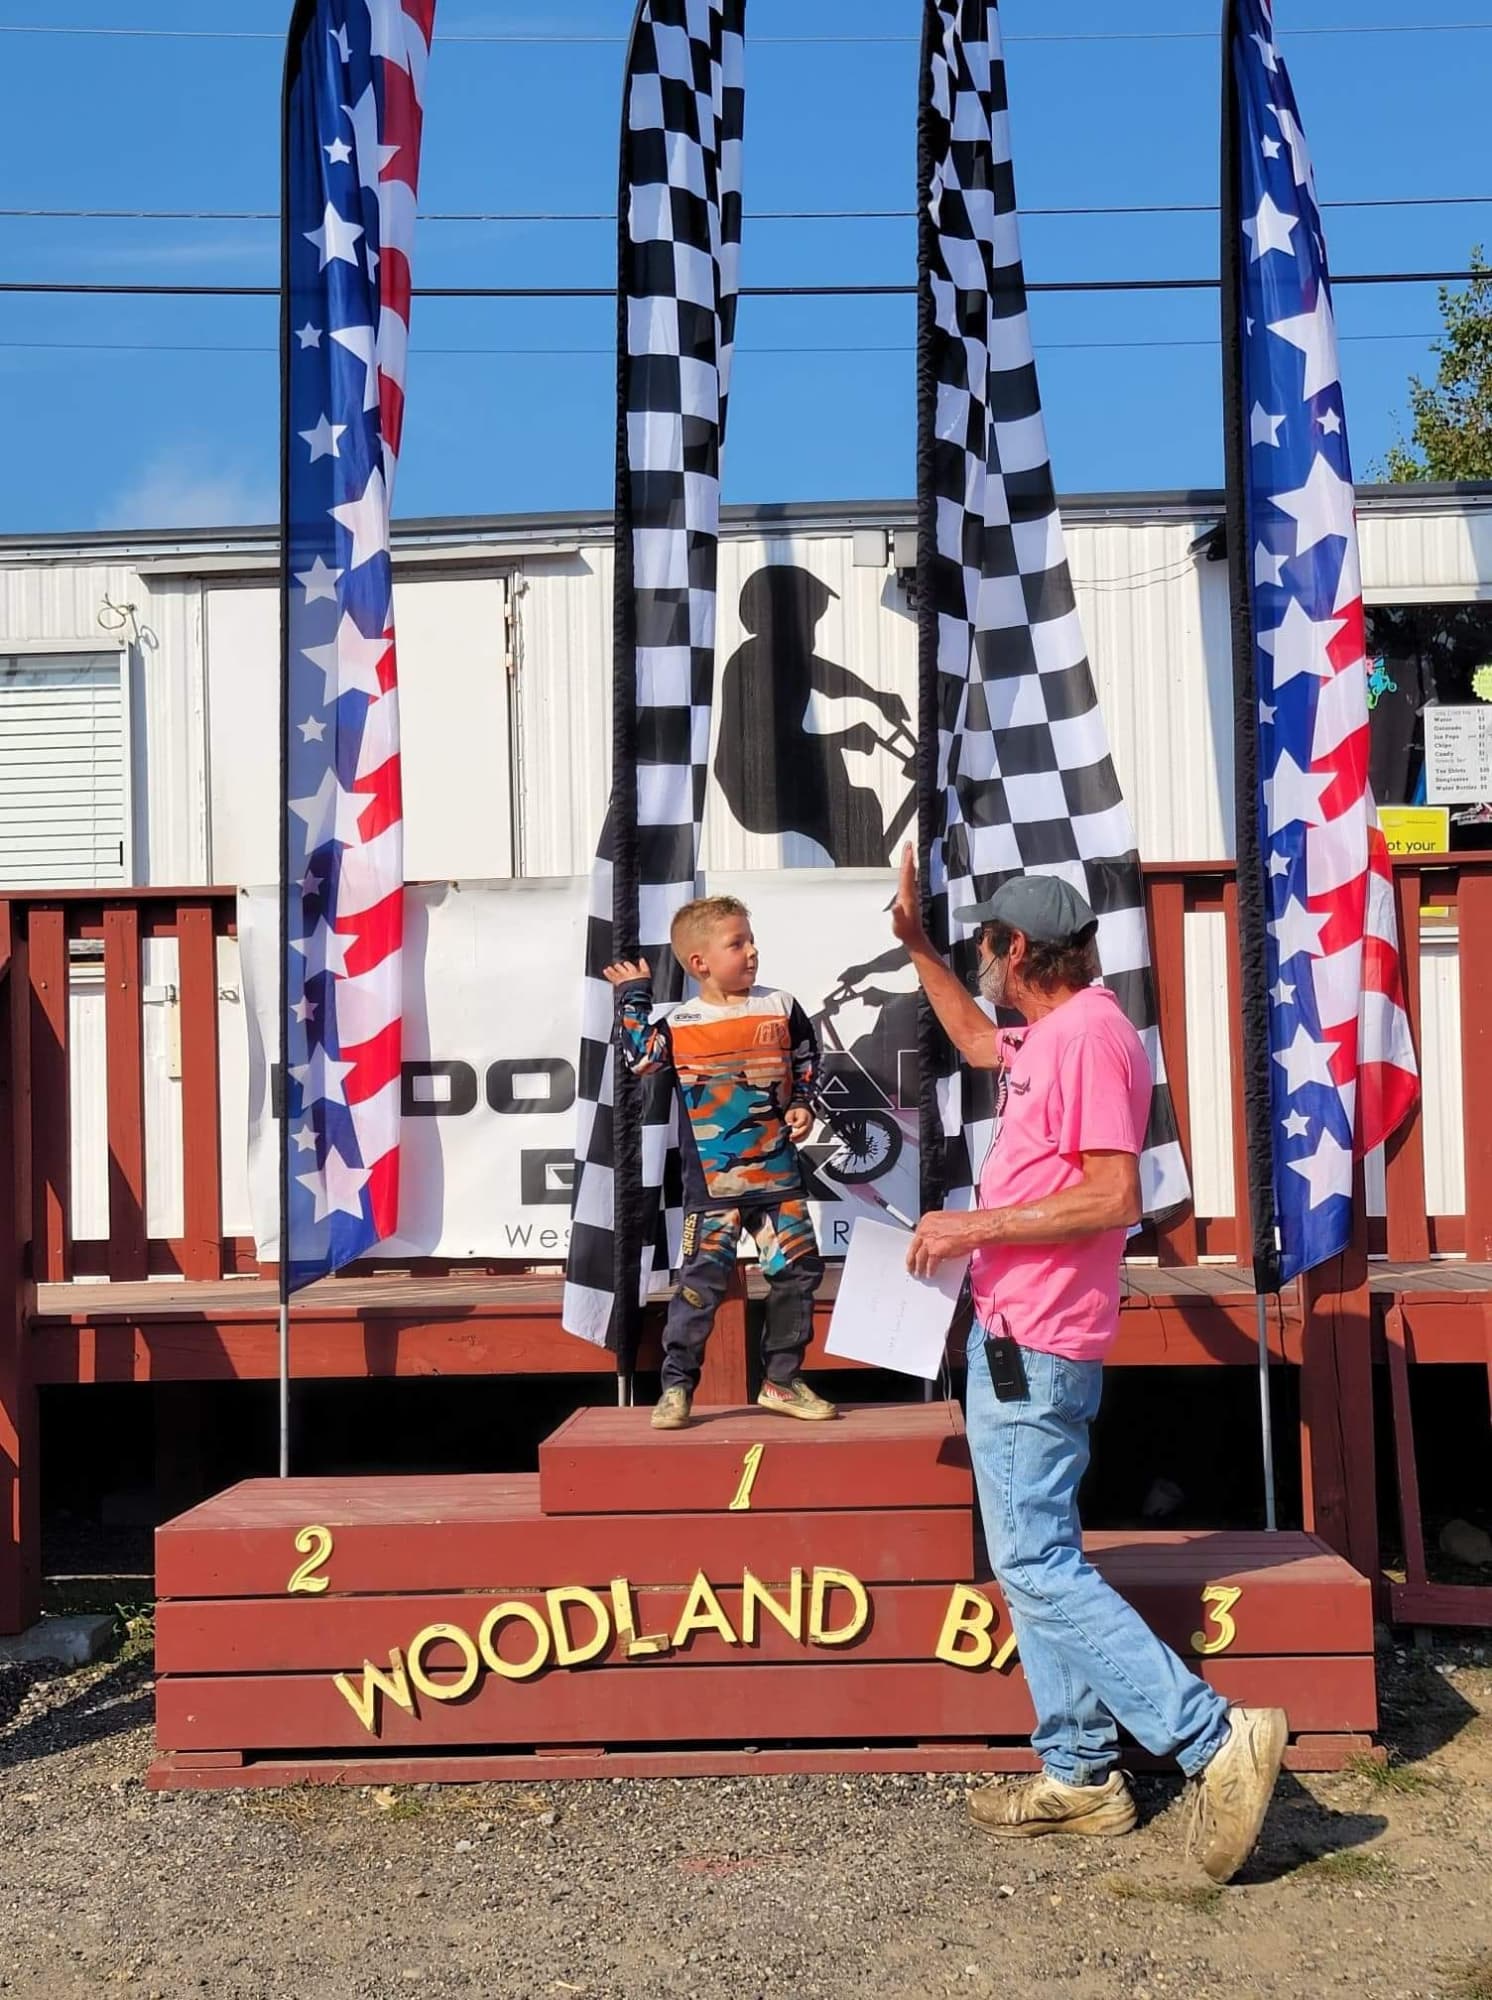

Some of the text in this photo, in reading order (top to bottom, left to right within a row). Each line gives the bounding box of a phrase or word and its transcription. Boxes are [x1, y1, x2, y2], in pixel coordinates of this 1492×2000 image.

[1387, 840, 1437, 854] ot your
[728, 1443, 764, 1511] 1
[287, 1525, 334, 1594] 2
[333, 1566, 869, 1733] WOODLAND
[1191, 1585, 1243, 1654] 3
